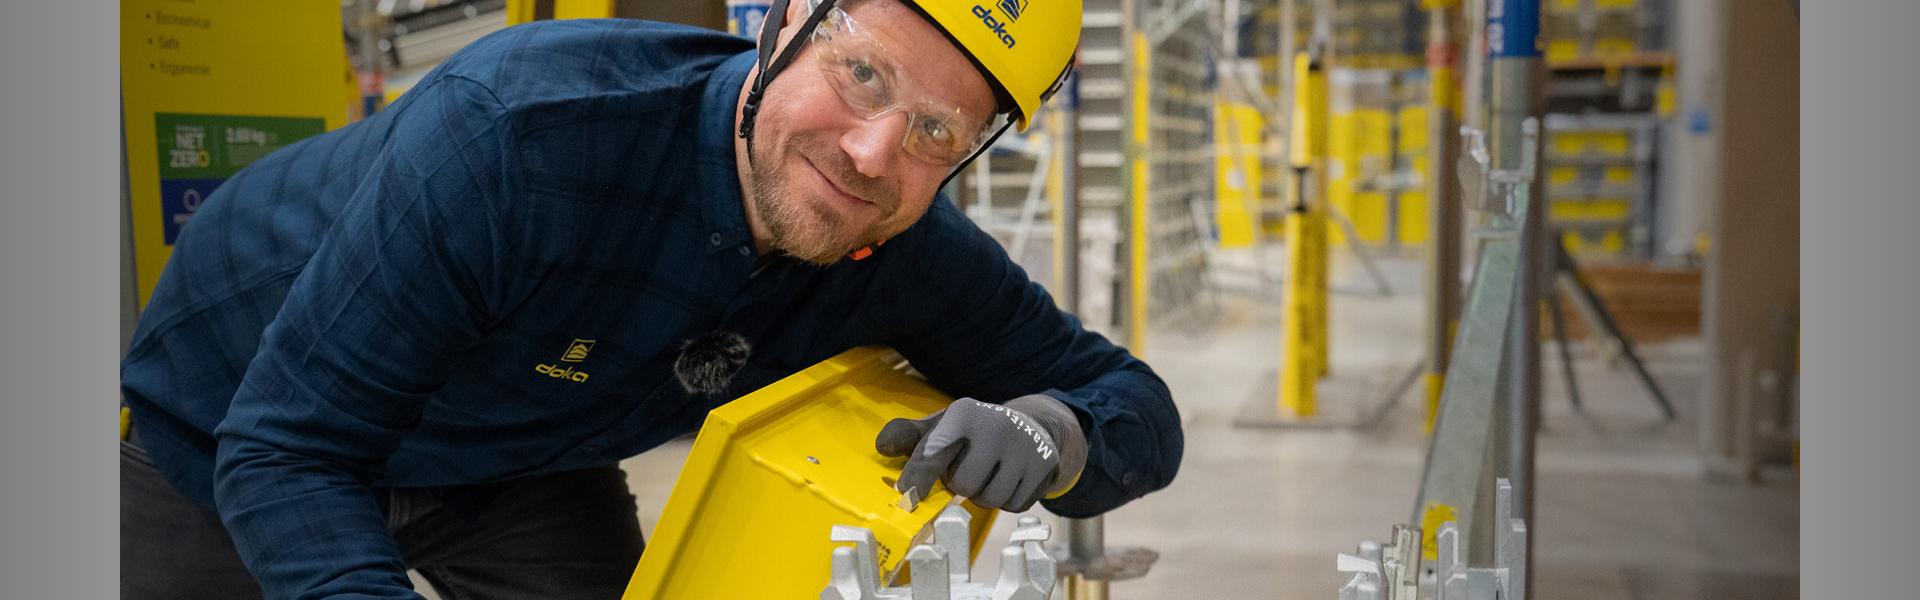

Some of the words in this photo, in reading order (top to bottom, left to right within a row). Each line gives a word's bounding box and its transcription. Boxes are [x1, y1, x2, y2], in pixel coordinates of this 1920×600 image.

[156, 10, 211, 28] Economical
[972, 4, 1016, 49] doka
[158, 35, 179, 49] Safe
[160, 60, 212, 76] Ergonomic
[175, 133, 205, 148] NET
[170, 149, 210, 168] ZERO
[535, 362, 590, 383] doka
[981, 402, 1053, 461] MaxiFlex
